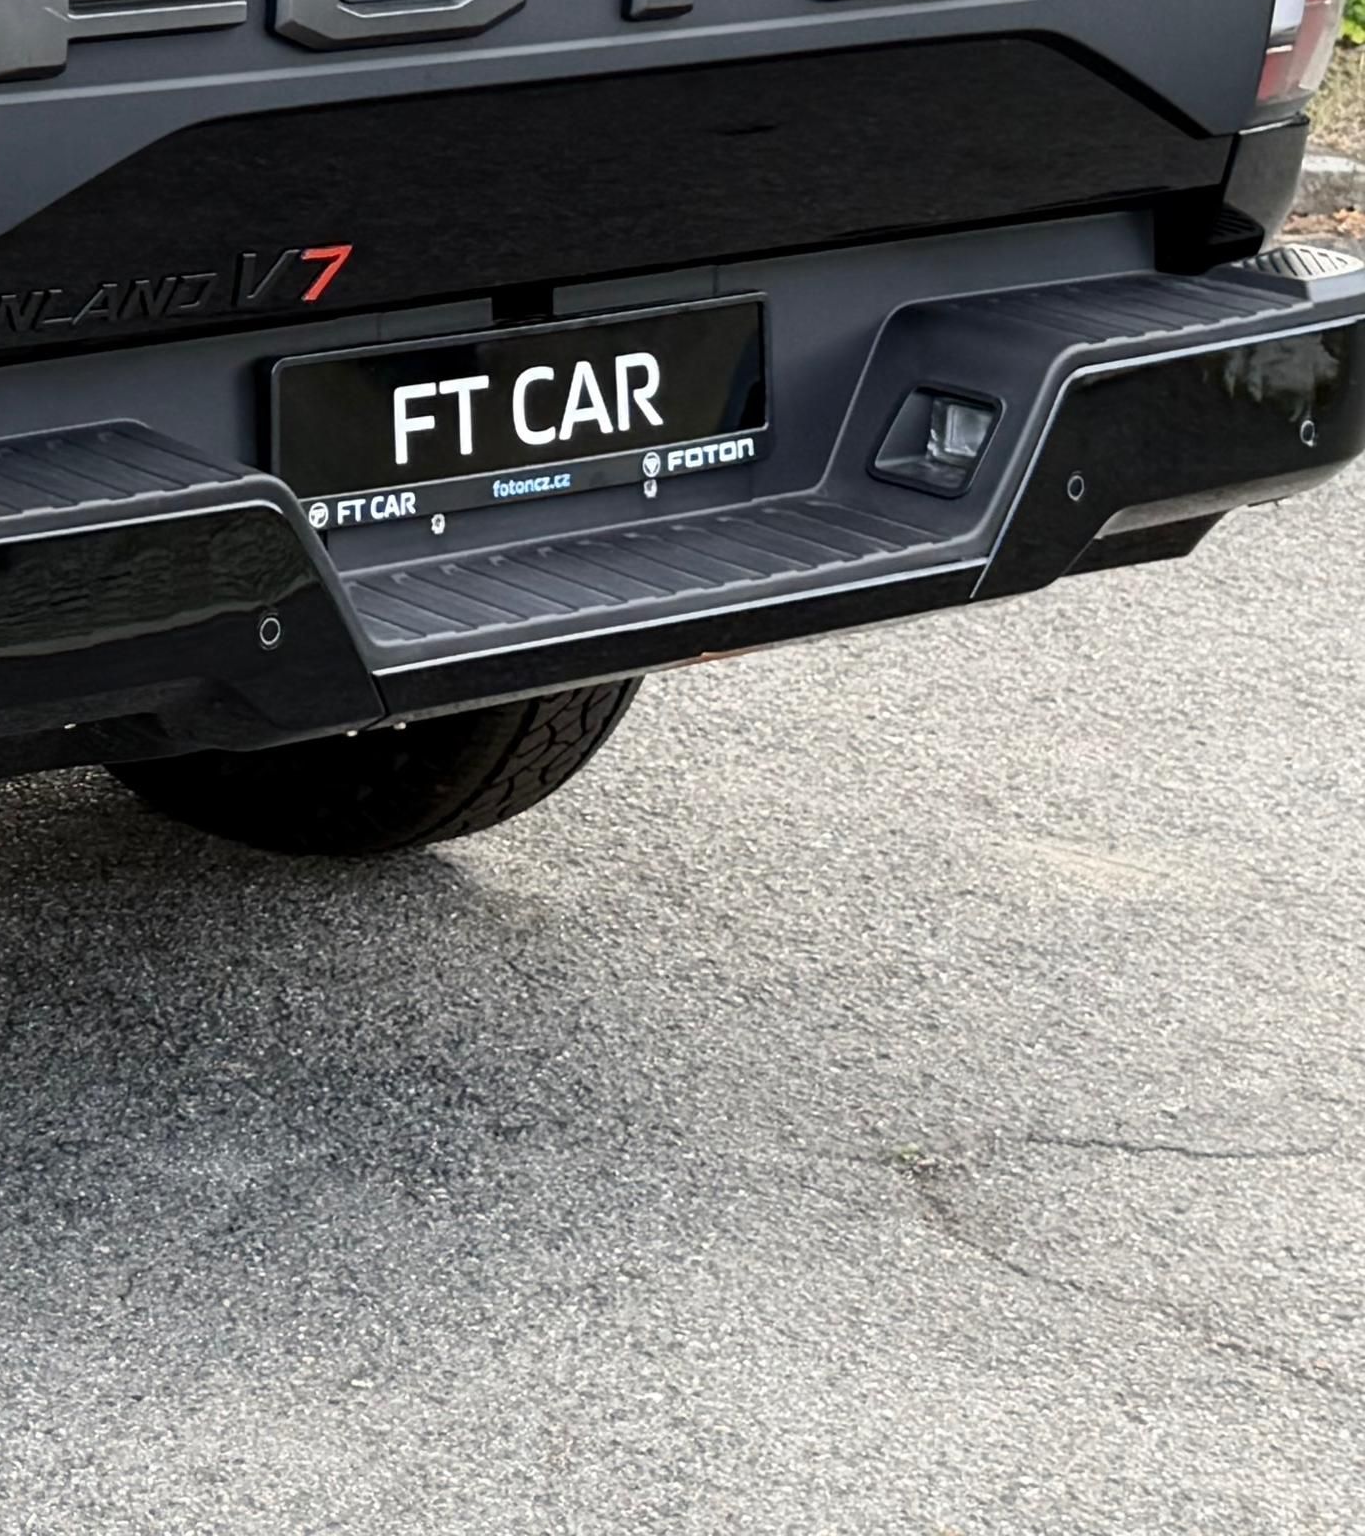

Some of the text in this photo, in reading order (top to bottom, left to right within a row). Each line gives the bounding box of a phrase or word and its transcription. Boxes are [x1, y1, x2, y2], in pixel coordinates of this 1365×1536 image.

[231, 240, 356, 308] V7
[393, 351, 663, 465] FT CAR
[667, 437, 755, 472] FOTON
[492, 472, 571, 499] fotoncz.cz
[337, 491, 416, 526] FT CAR
